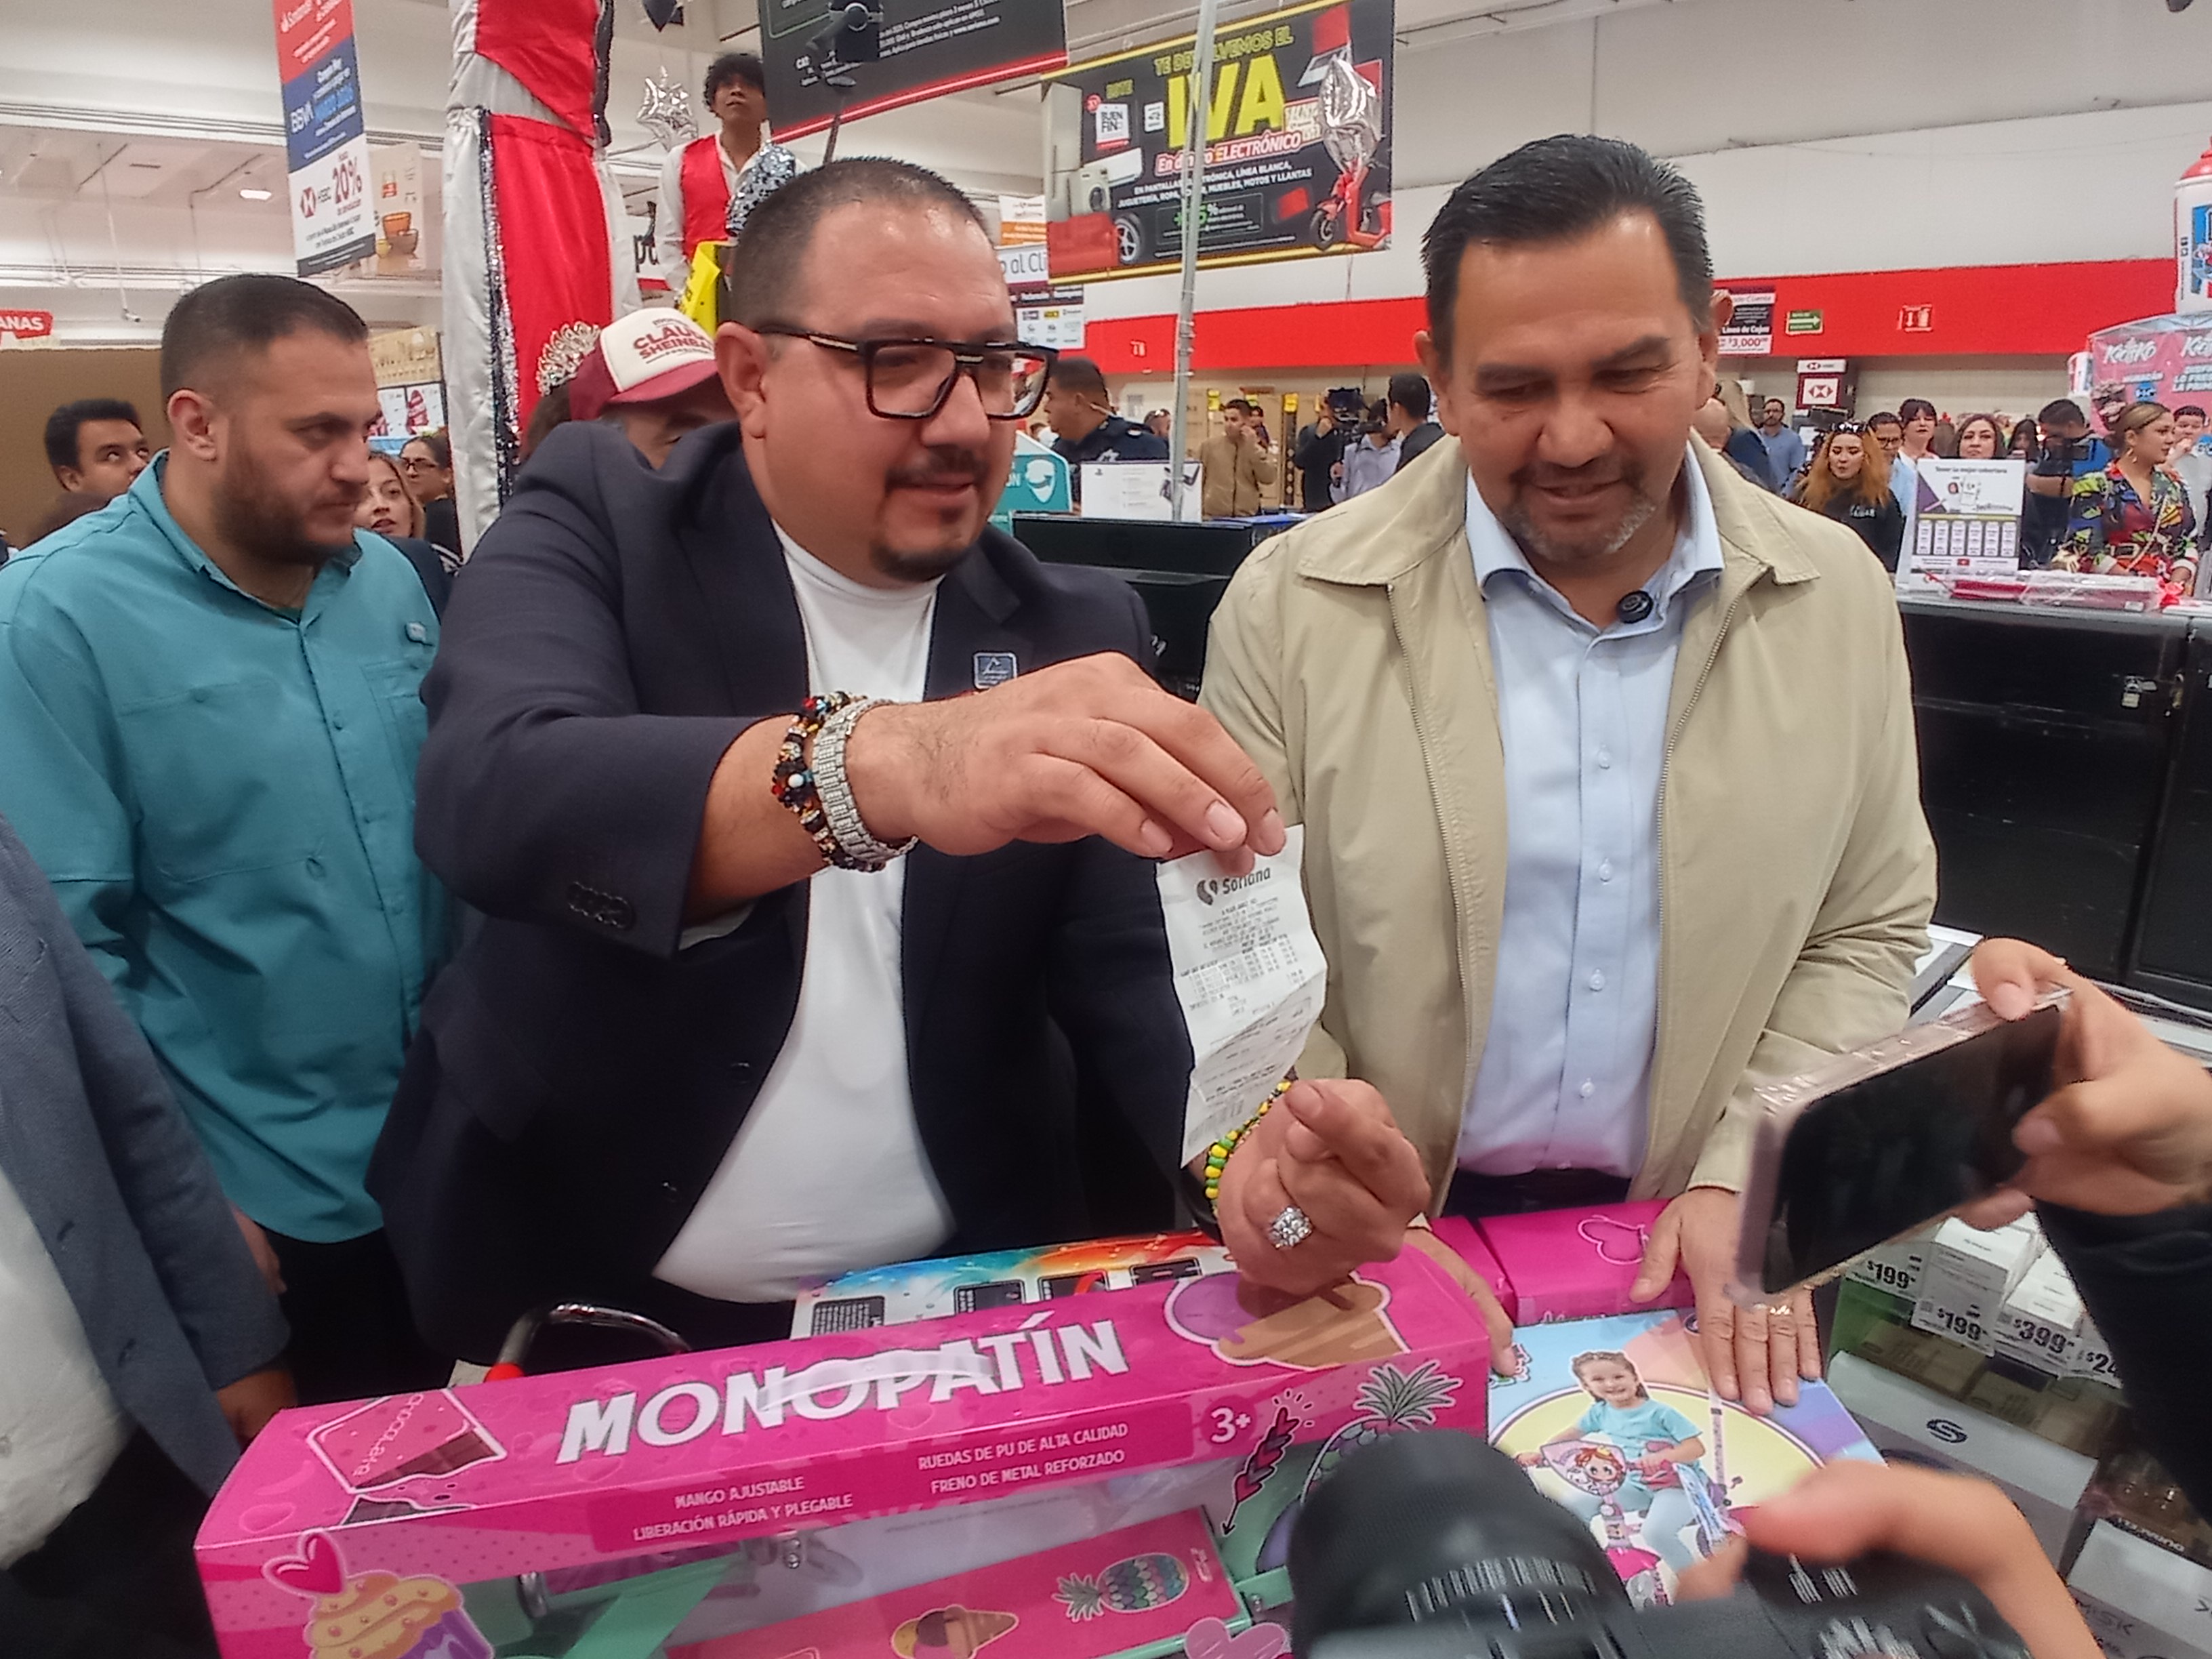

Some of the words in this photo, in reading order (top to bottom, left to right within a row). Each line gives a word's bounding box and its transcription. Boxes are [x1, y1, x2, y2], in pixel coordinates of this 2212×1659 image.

[1274, 26, 1294, 47] EL
[1158, 157, 1173, 170] En
[1215, 130, 1301, 162] ELECTRÓNICO
[331, 156, 362, 204] 20%
[1010, 253, 1025, 274] al
[555, 1311, 1130, 1465] MONOPATÍN
[1210, 1407, 1251, 1443] 3+
[918, 1449, 972, 1470] RUEDAS
[975, 1446, 994, 1462] DE
[996, 1442, 1015, 1458] PU
[1018, 1439, 1037, 1455] DE
[1039, 1433, 1071, 1451] ALTA
[1073, 1423, 1128, 1445] CALIDAD
[674, 1489, 725, 1509] MANGO
[729, 1476, 805, 1502] AJUSTABLE
[931, 1475, 977, 1494] FRENO
[980, 1471, 999, 1486] DE
[1002, 1465, 1042, 1483] METAL
[1044, 1450, 1125, 1475] REFORZADO
[633, 1514, 714, 1542] LIBERACIÓN
[716, 1508, 768, 1528] RÁPIDA
[771, 1505, 782, 1519] Y
[785, 1493, 853, 1517] PLEGABLE
